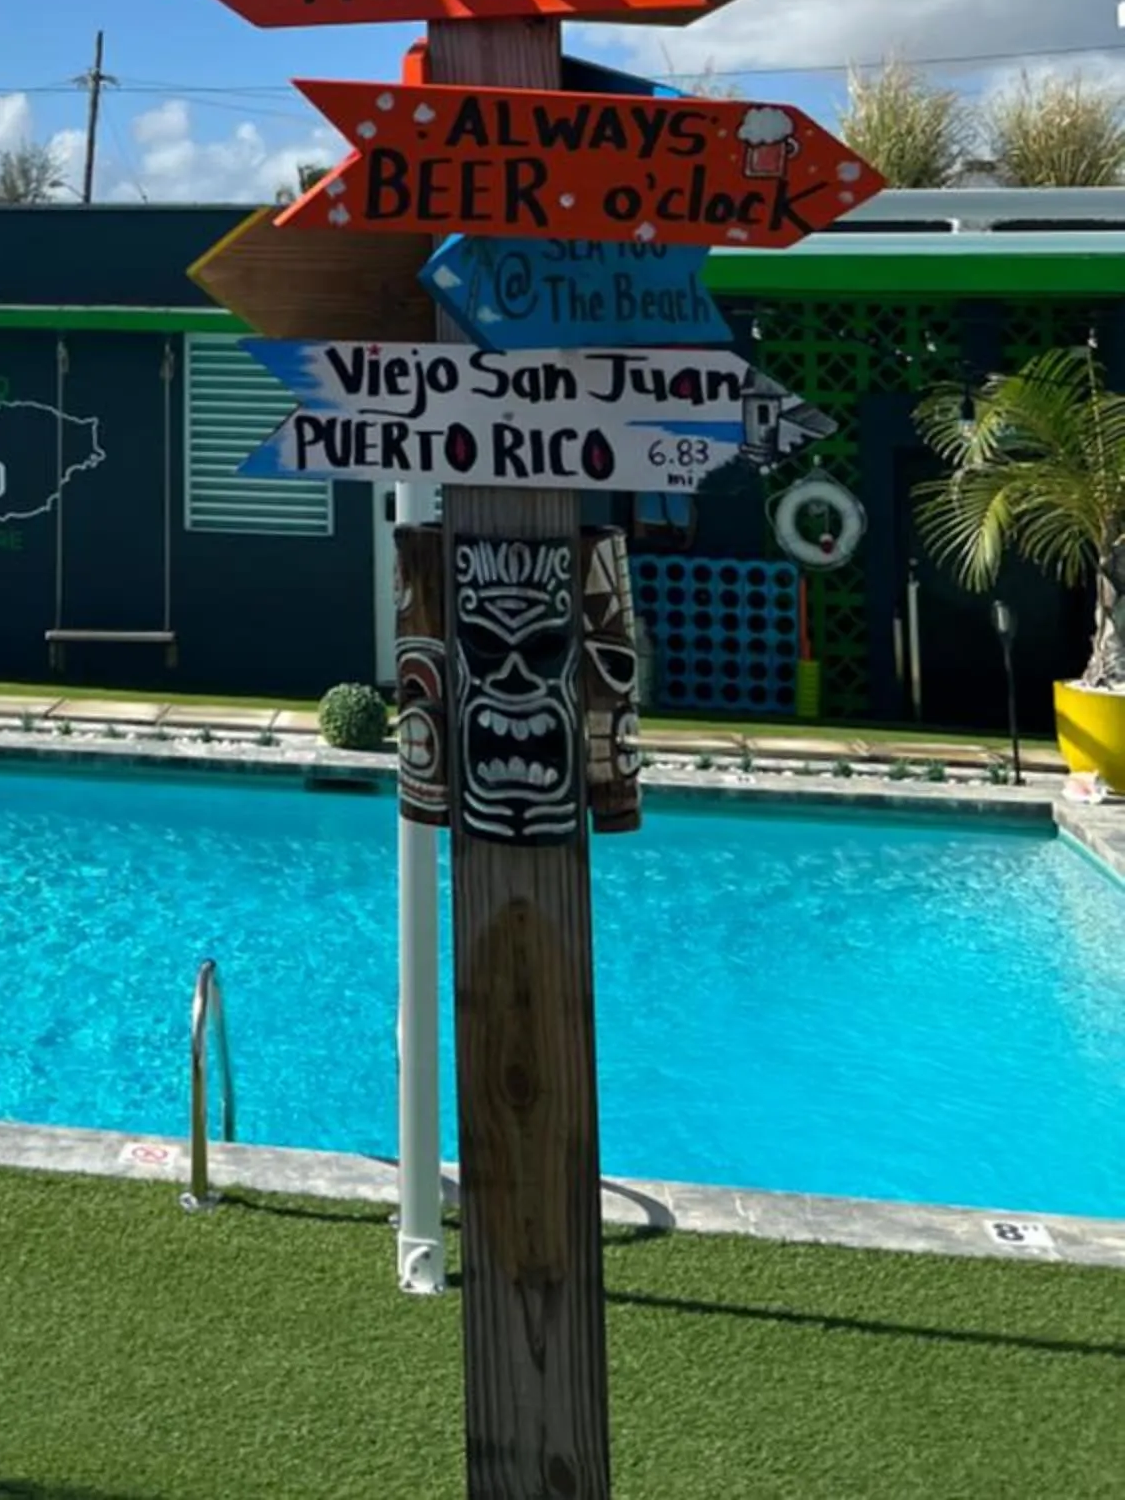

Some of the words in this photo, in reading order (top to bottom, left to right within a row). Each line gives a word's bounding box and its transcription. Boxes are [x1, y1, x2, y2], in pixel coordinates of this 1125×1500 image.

[445, 96, 708, 159] ALWAYS
[364, 146, 550, 229] BEER
[541, 273, 606, 324] The
[613, 272, 712, 323] Beach
[325, 342, 459, 419] Viejo
[468, 349, 577, 402] San
[586, 353, 744, 402] Juan
[294, 414, 478, 473] PUERTO
[492, 421, 616, 481] RICO
[647, 438, 711, 468] 6.83
